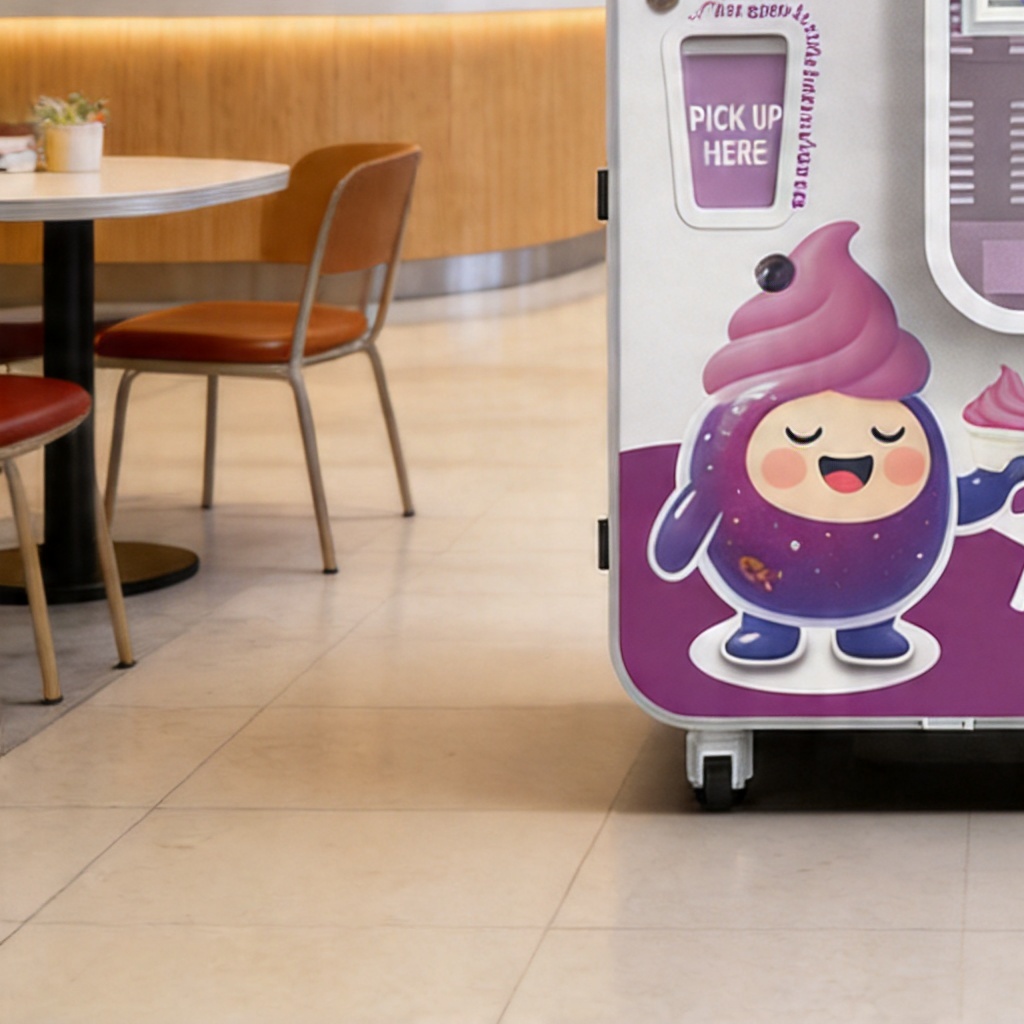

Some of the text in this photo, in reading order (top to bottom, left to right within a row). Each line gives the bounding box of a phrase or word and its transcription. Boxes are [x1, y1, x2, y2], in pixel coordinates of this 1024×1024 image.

[690, 104, 783, 132] PICK UP
[703, 139, 769, 167] HERE
